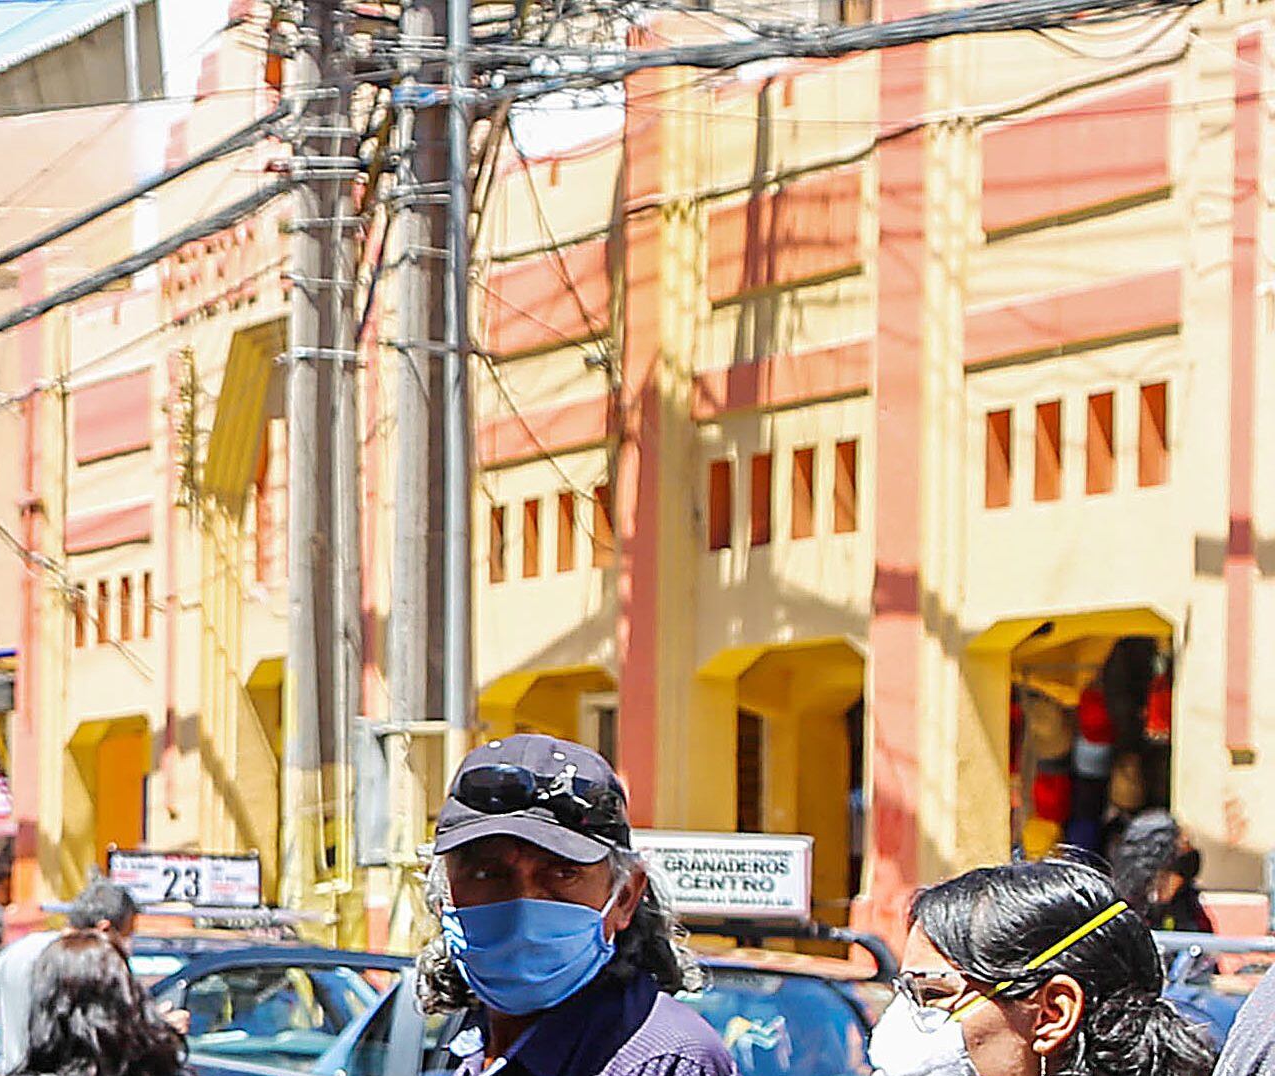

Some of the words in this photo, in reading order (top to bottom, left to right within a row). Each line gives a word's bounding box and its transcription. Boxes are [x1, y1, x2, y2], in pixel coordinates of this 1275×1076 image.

[664, 857, 790, 875] GRANADEROS
[163, 866, 200, 902] 23
[678, 874, 775, 892] CENTRO
